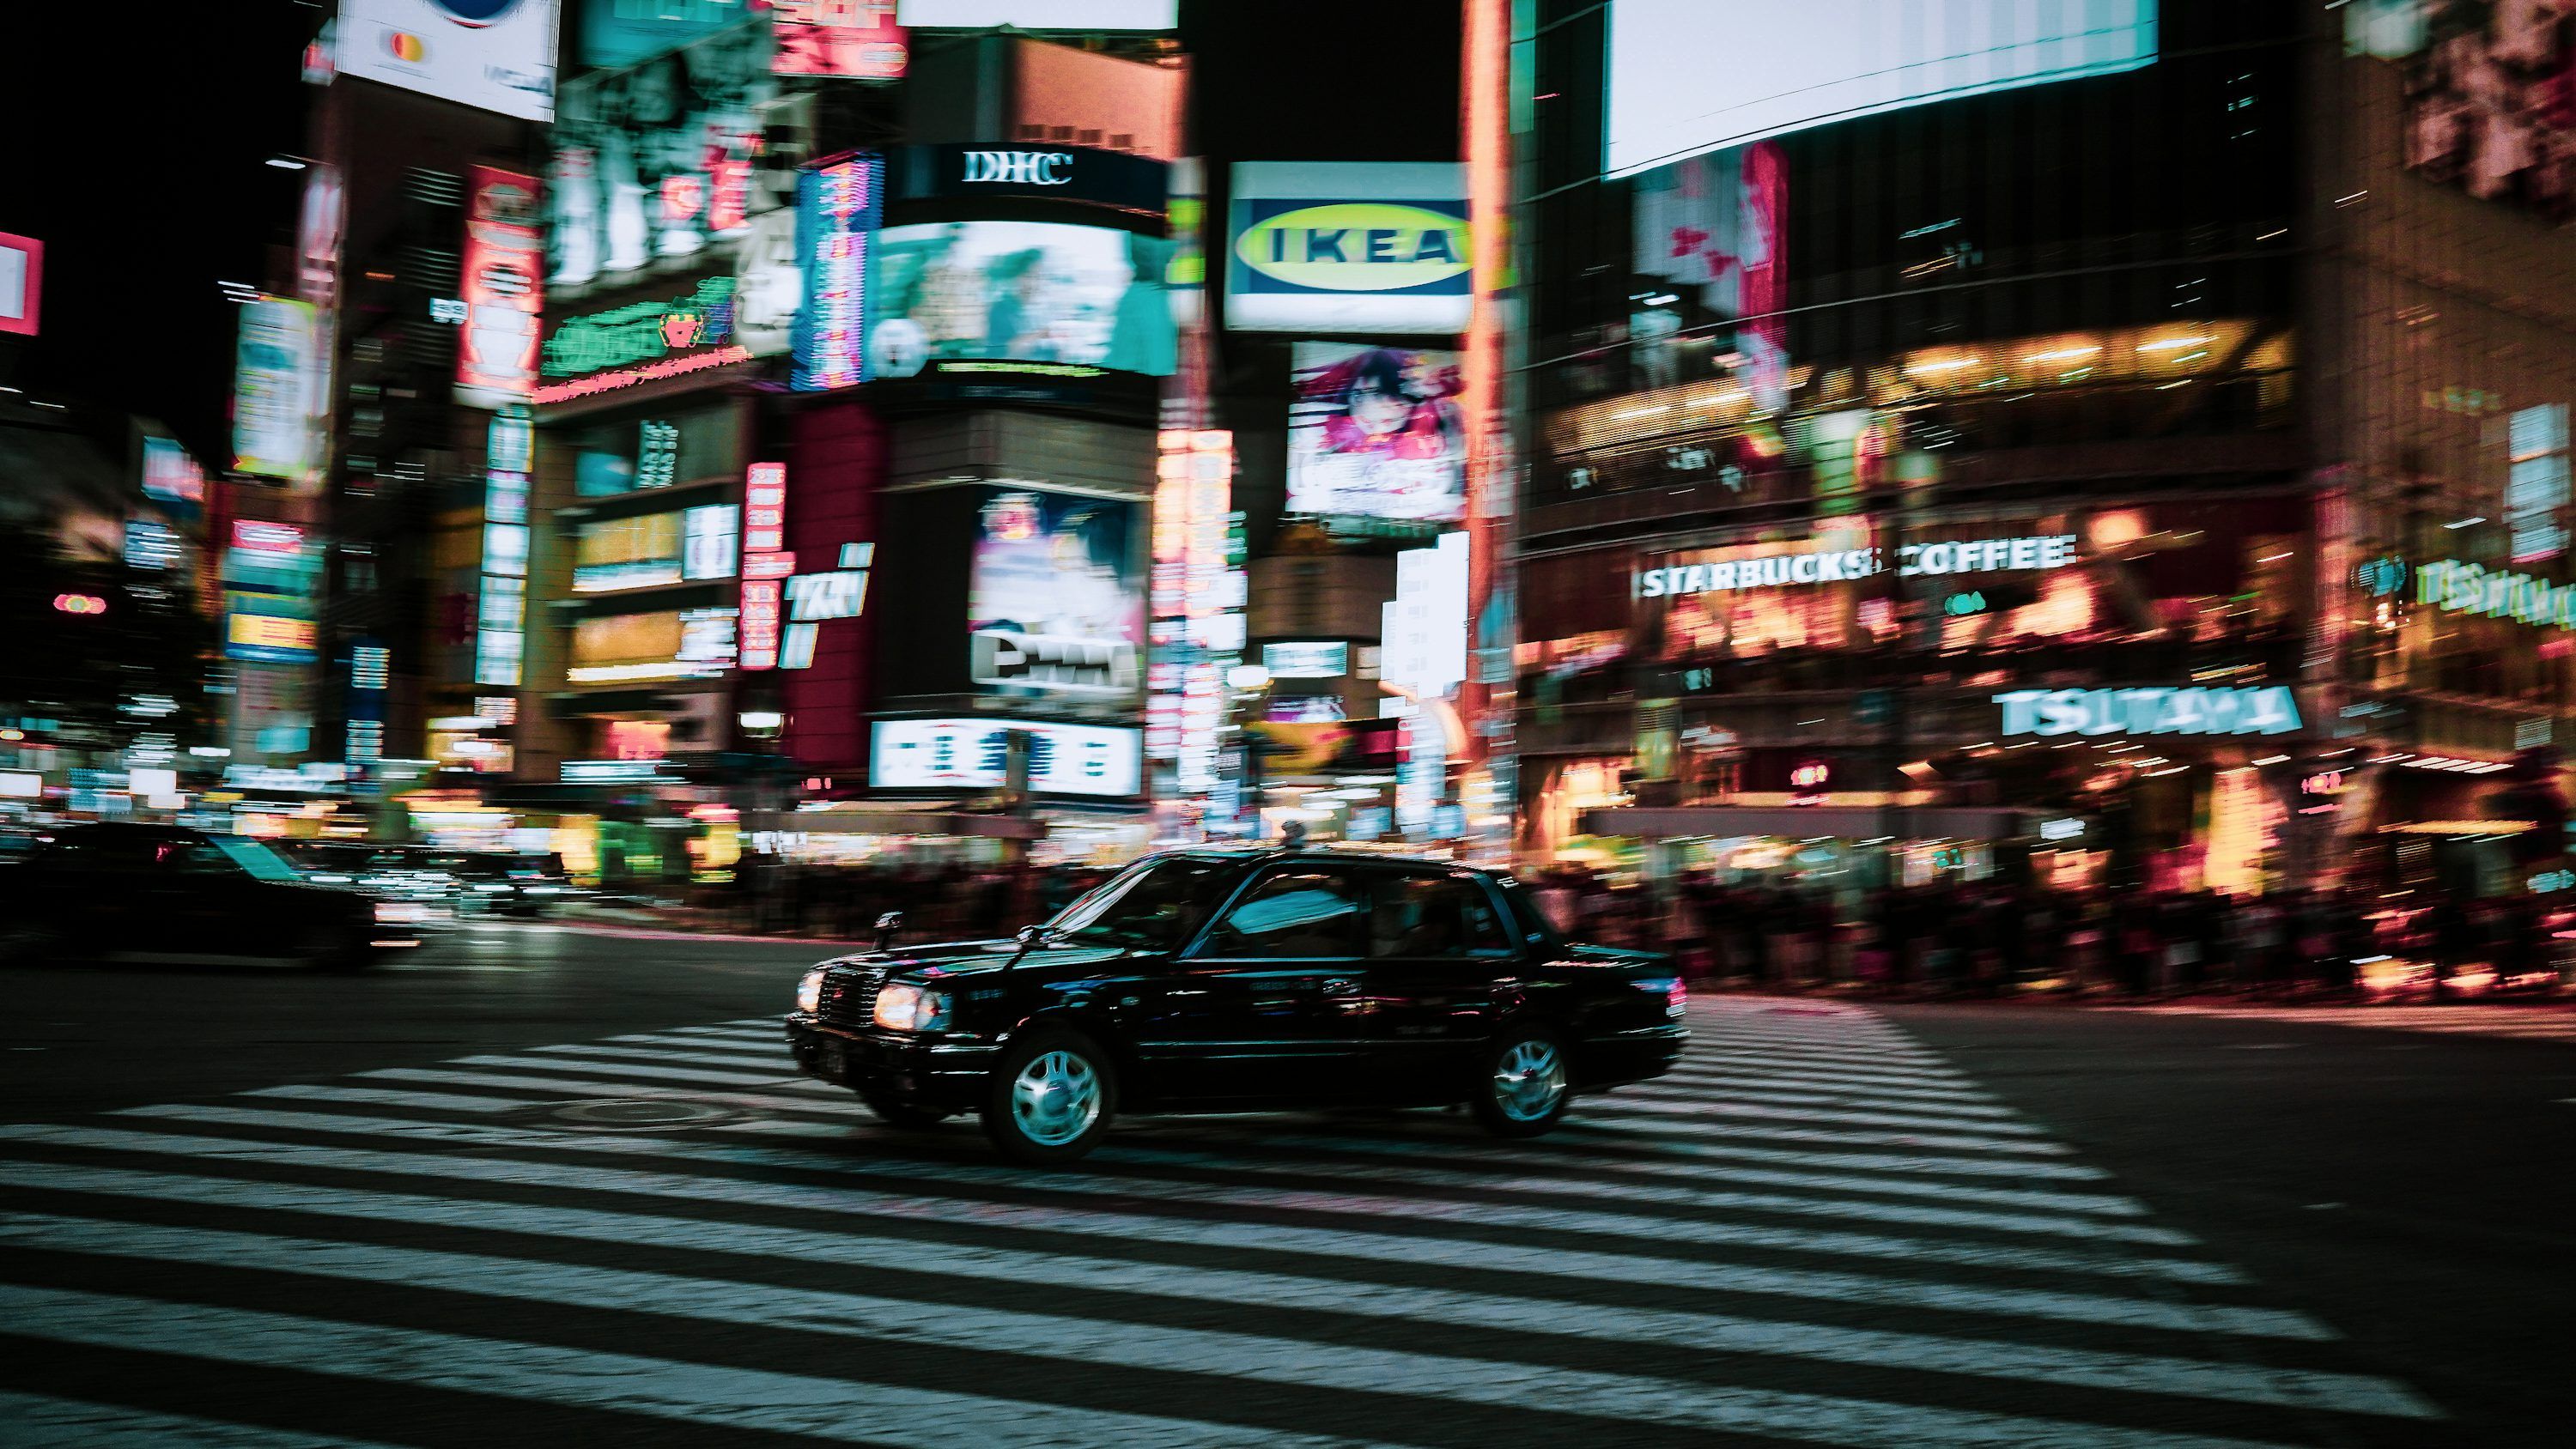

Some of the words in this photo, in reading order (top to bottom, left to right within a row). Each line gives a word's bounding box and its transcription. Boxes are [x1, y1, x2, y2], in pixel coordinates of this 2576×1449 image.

[962, 151, 1072, 185] DHC
[1272, 228, 1458, 263] IKEA
[1641, 546, 1883, 597] STARBUCKS
[1894, 535, 2076, 576] COFFEE
[1992, 686, 2303, 736] TSUTAYA
